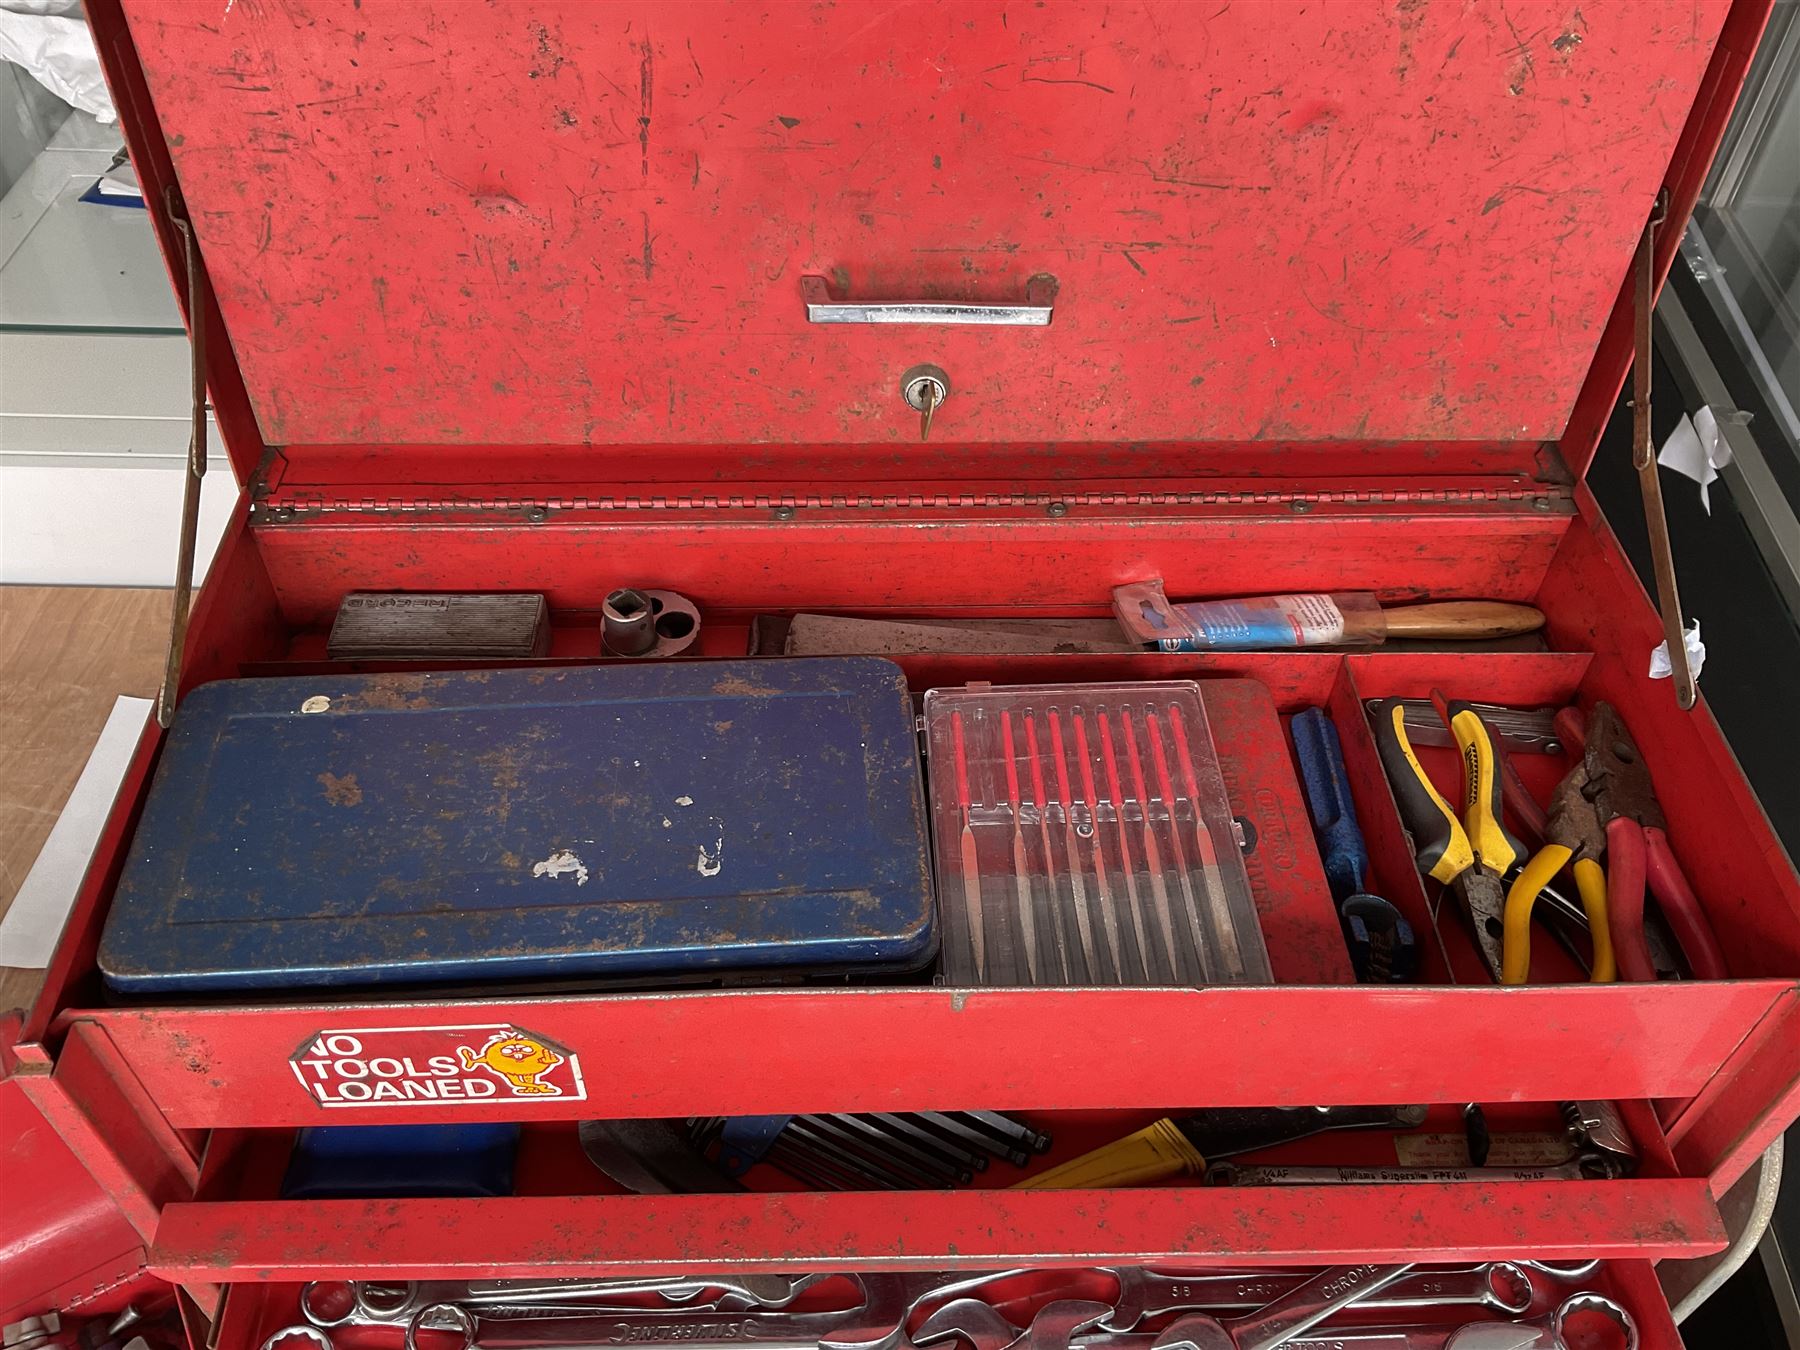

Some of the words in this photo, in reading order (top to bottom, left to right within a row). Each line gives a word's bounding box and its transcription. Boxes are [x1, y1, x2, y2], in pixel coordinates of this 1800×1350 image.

[310, 1034, 363, 1057] NO
[301, 1056, 459, 1080] TOOLS
[312, 1077, 497, 1101] LOANED
[1321, 1262, 1379, 1301] CHROME
[630, 1323, 741, 1342] SILVERLINE
